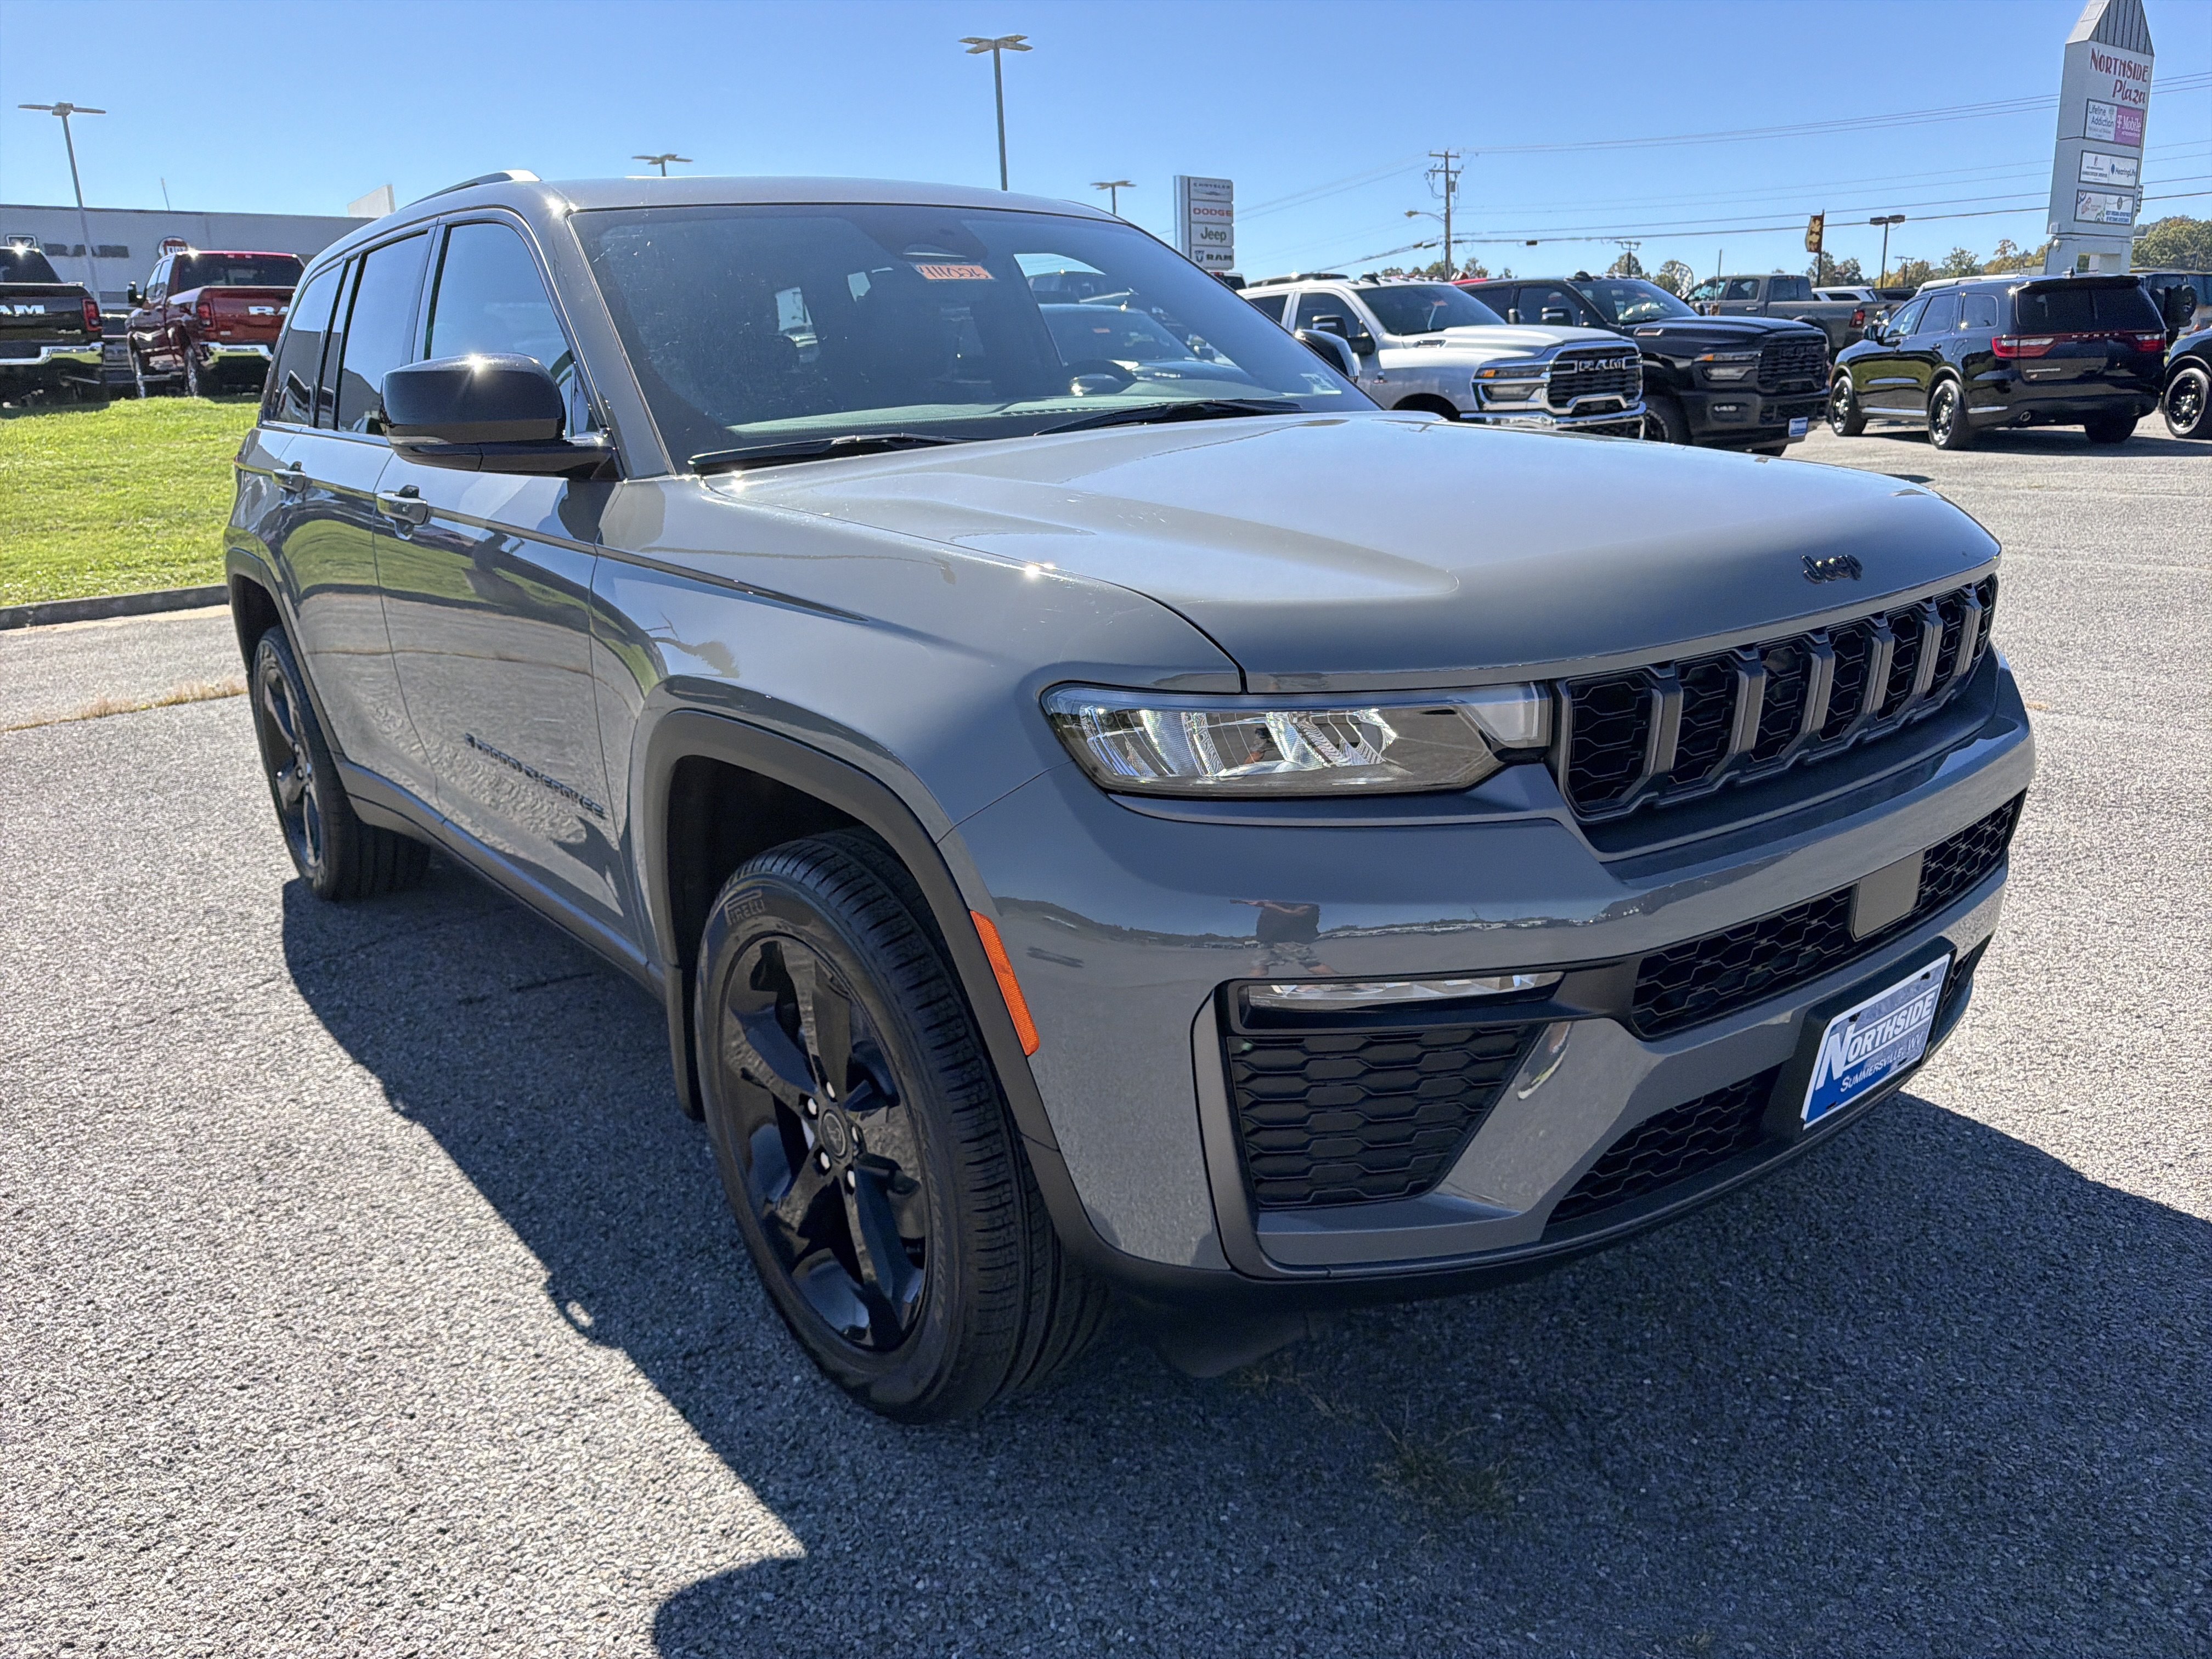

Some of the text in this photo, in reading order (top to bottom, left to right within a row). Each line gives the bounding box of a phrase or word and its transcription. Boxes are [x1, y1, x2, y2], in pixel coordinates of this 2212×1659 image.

[2090, 48, 2149, 82] NORTHSIDE
[2112, 79, 2146, 105] Plaza
[2091, 116, 2114, 128] Addiction
[1193, 207, 1233, 217] DODGE
[1200, 226, 1227, 243] Jeep
[1206, 253, 1232, 262] RAM
[1579, 358, 1623, 372] RAM
[1799, 554, 1863, 585] Jeep
[1815, 991, 1936, 1091] NORTHSIDE
[1907, 1030, 1923, 1051] WV
